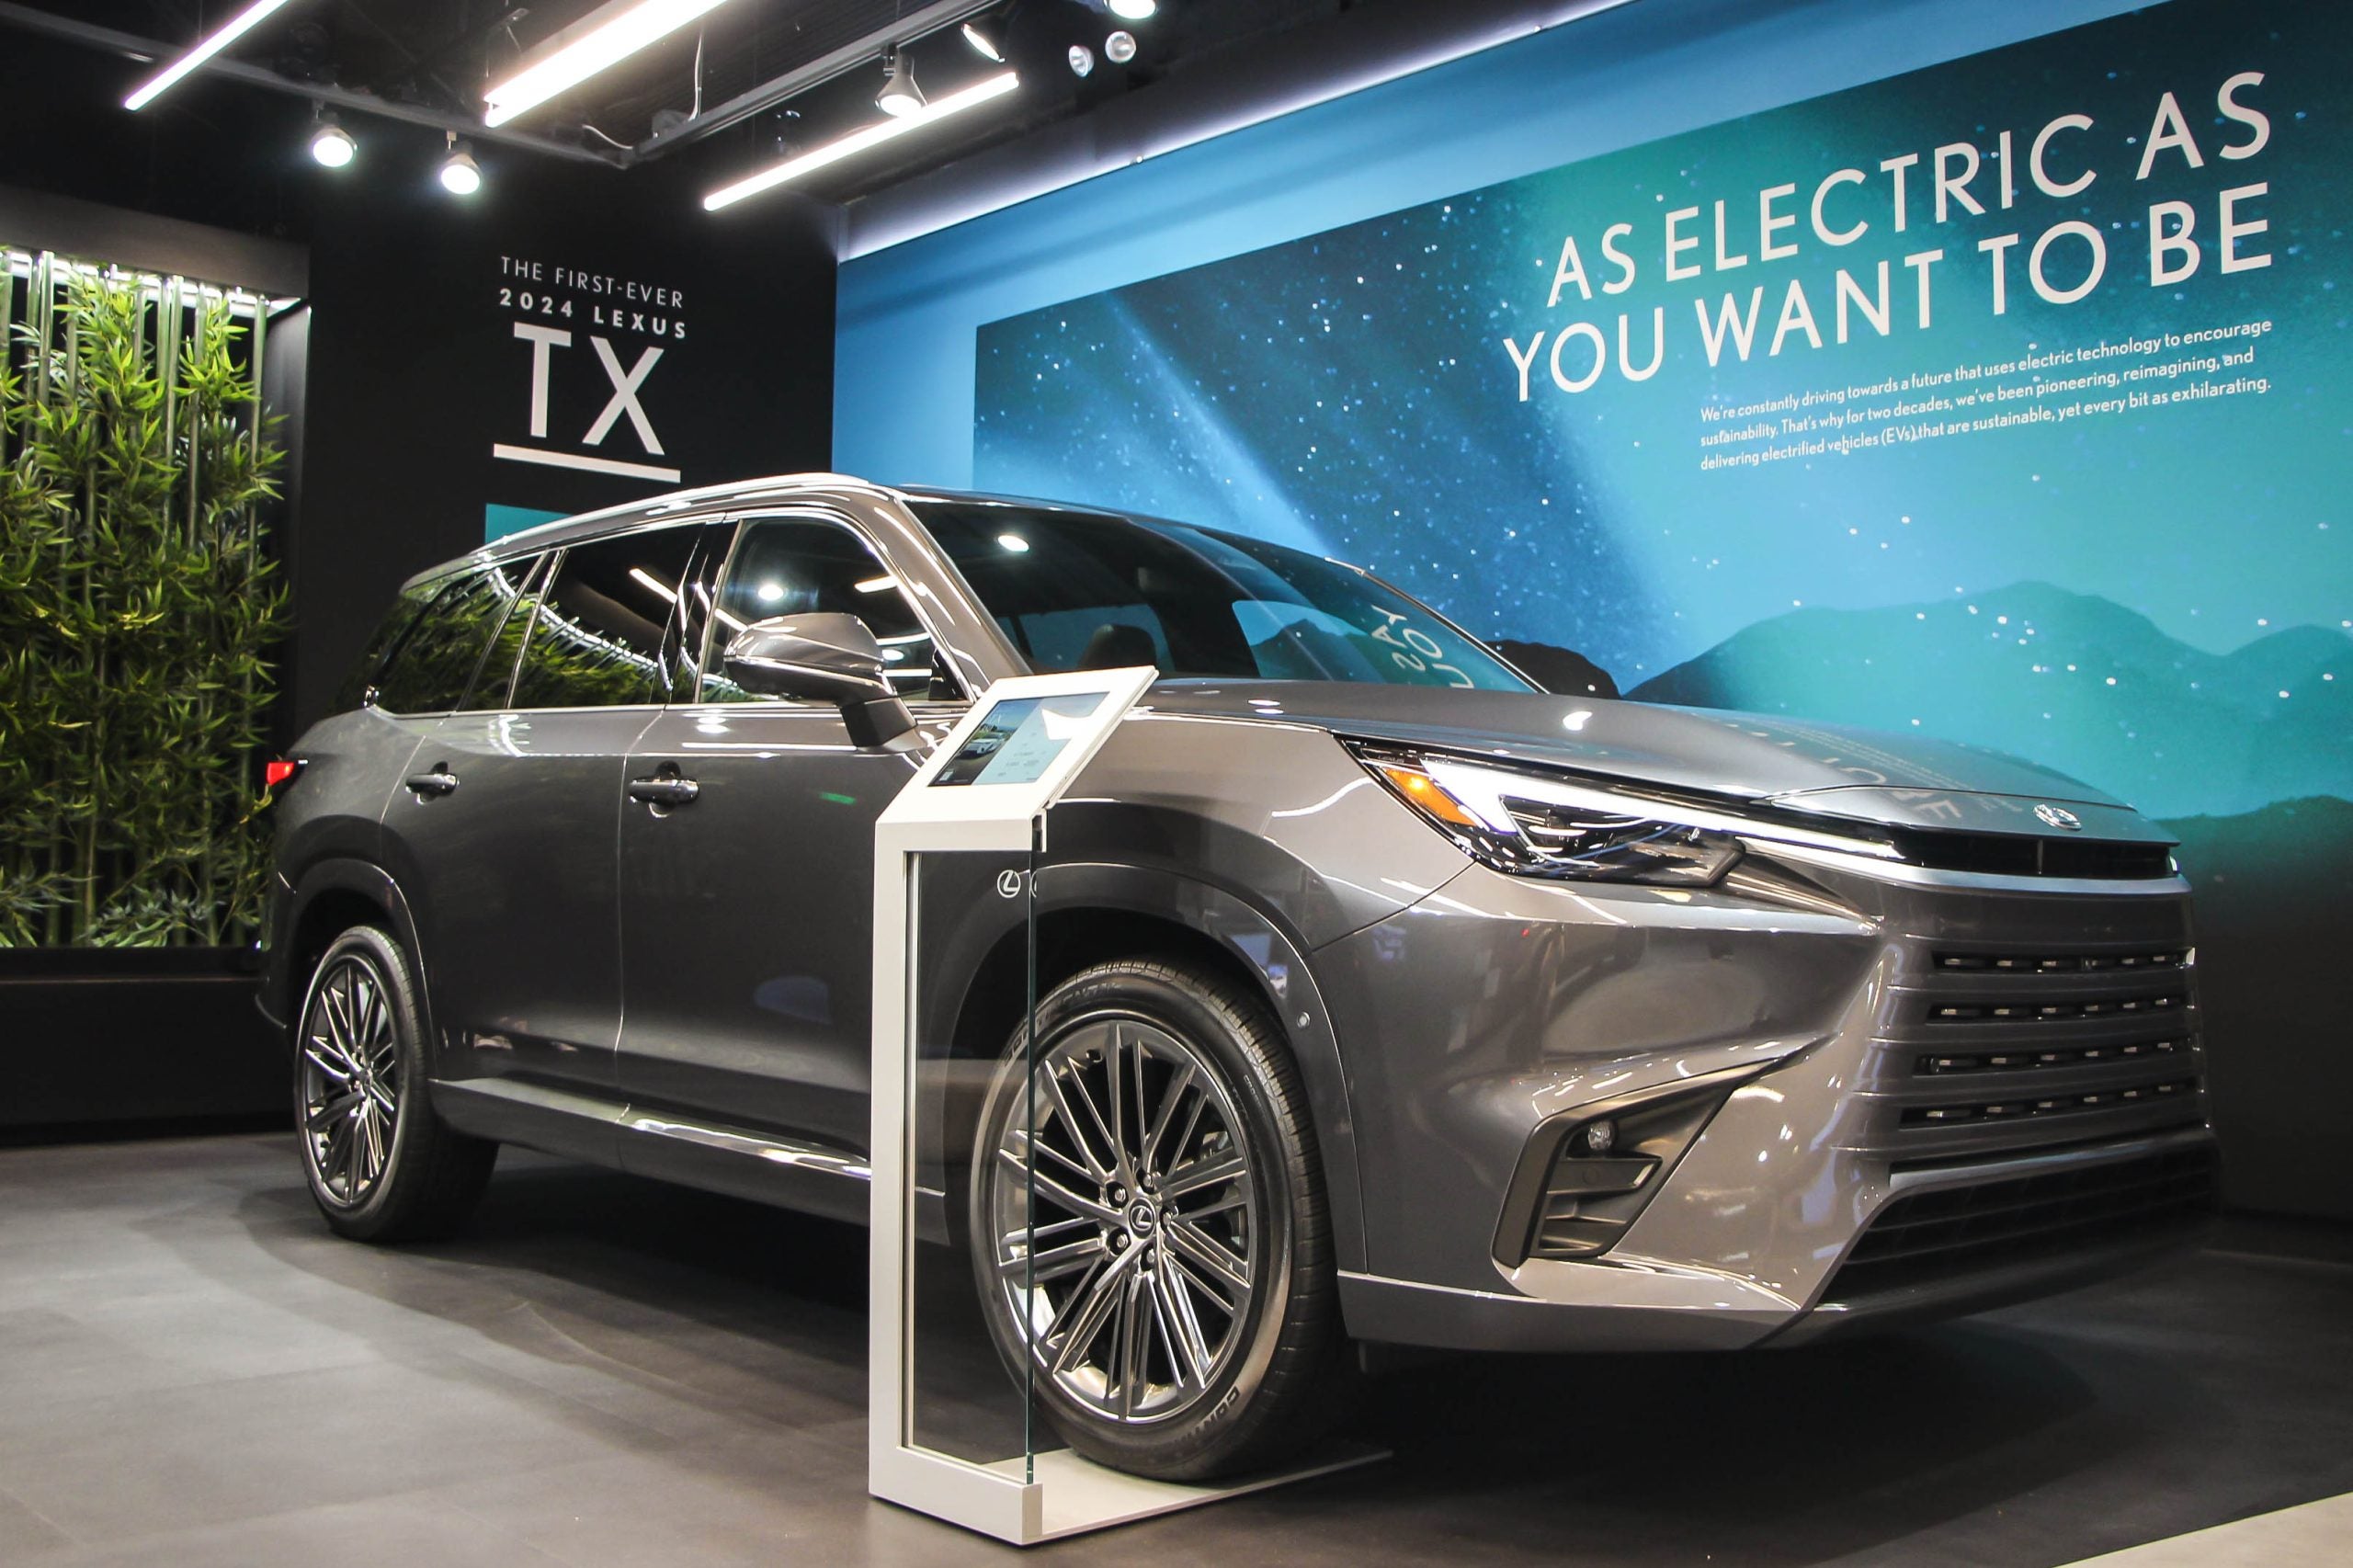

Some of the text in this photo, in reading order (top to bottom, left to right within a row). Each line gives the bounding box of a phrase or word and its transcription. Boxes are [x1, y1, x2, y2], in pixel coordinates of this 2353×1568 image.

[1547, 72, 2272, 307] AS ELECTRIC AS
[499, 288, 686, 339] 2024 LEXUS
[501, 256, 683, 309] THE FIRST-EVER
[1503, 181, 2273, 403] YOU WANT TO BE
[513, 321, 665, 456] TX
[1700, 320, 2272, 423] We're constantly driving towards a future that uses electric technology to encourage
[1700, 345, 2255, 448] sustainability. That's why for two decades, we've been pioneering, reimagining, and
[1700, 453, 1760, 471] delivering
[1762, 437, 1825, 462] electrified
[1827, 431, 1880, 453] vehicles
[1917, 422, 1946, 439] that
[1947, 421, 1971, 436] are
[1972, 404, 2056, 431] sustainable,
[2058, 403, 2079, 422] yet
[2083, 398, 2126, 415] every
[2129, 392, 2149, 409] bit
[2152, 392, 2169, 406] as
[2171, 378, 2272, 403] exhilarating.
